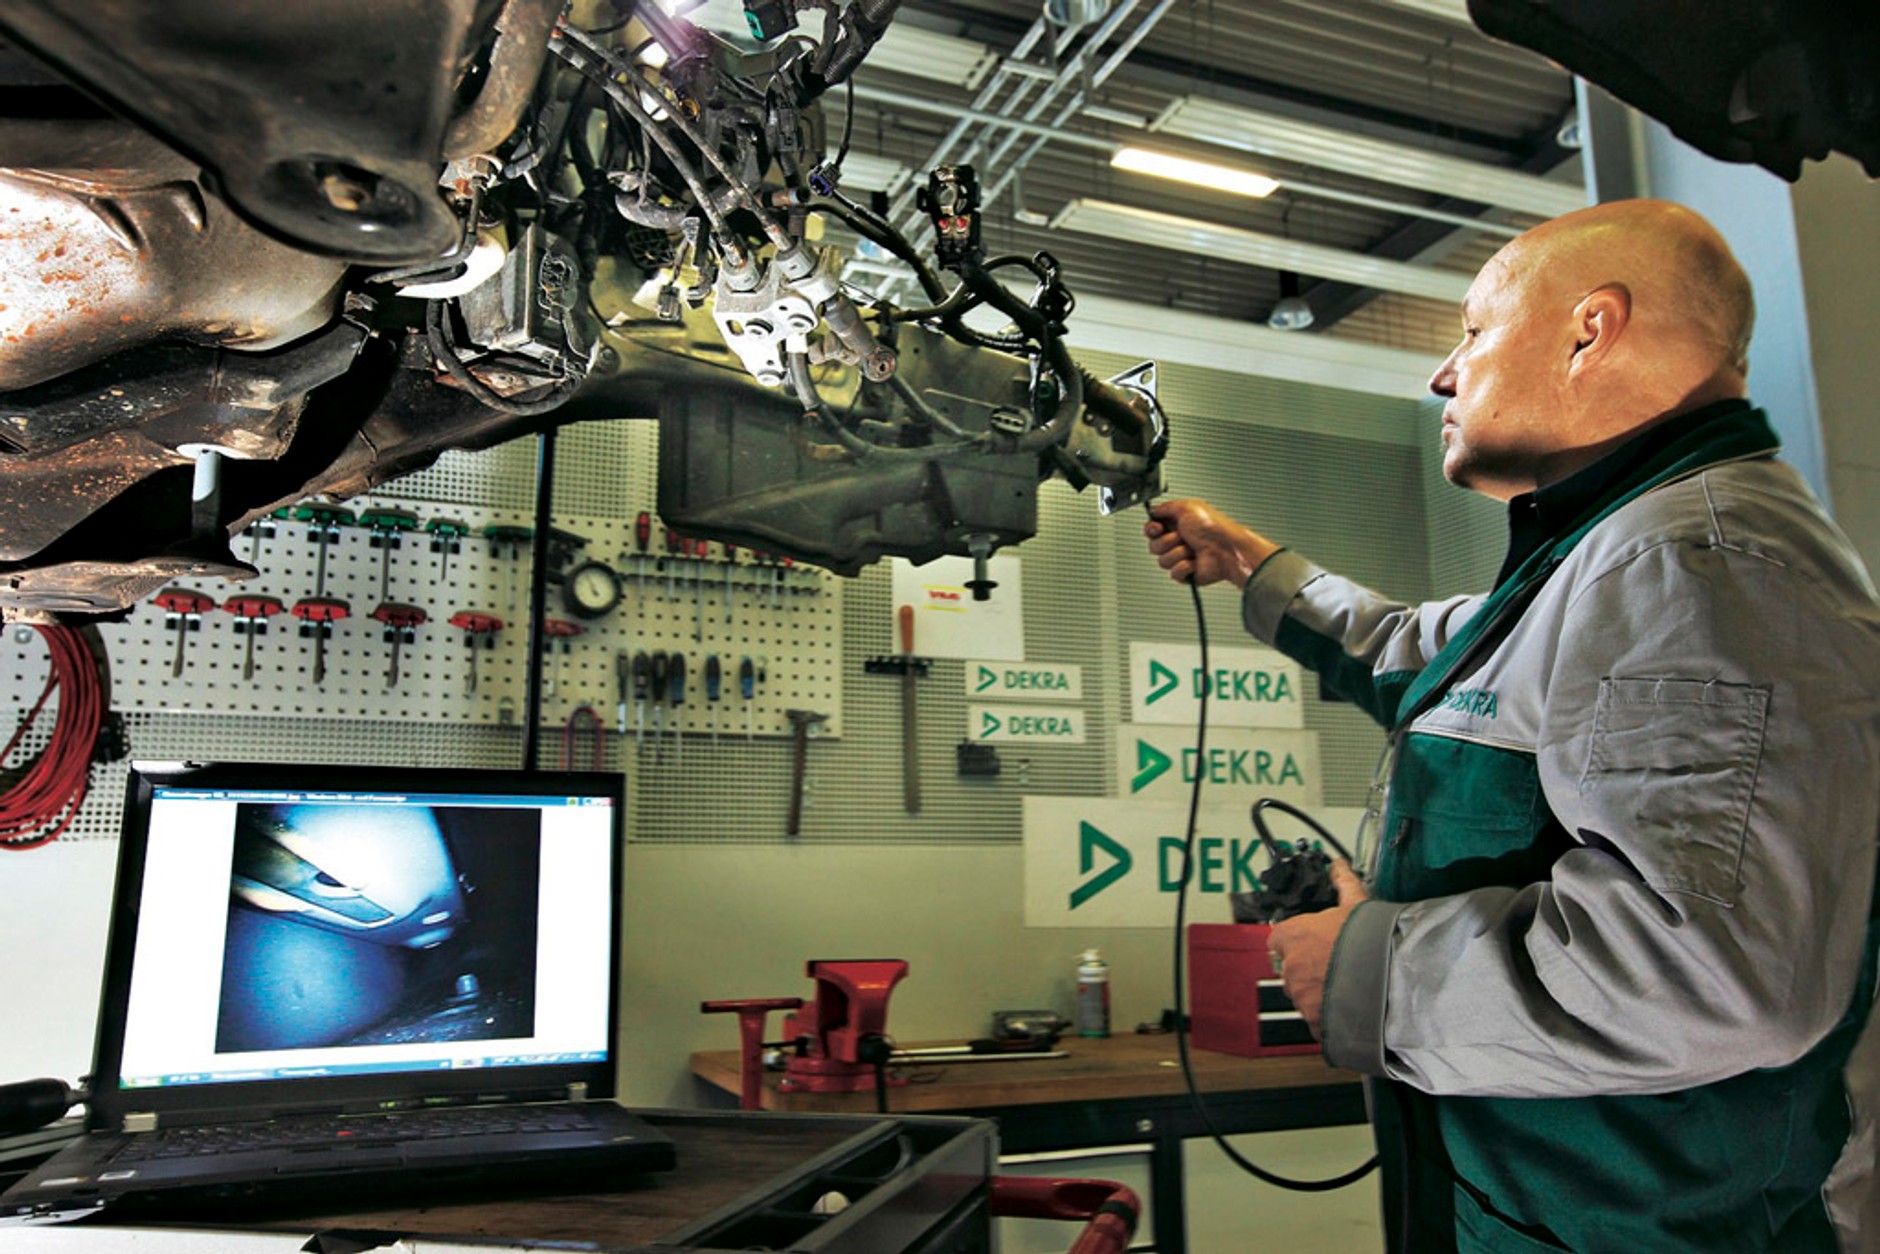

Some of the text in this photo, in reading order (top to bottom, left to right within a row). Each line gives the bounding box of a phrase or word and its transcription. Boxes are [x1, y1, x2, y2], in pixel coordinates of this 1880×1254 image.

[1004, 670, 1069, 690] DEKRA
[1192, 668, 1295, 702] DEKRA
[1008, 716, 1073, 736] DEKRA
[1182, 748, 1304, 786] DEKRA
[1157, 837, 1324, 893] DEK
